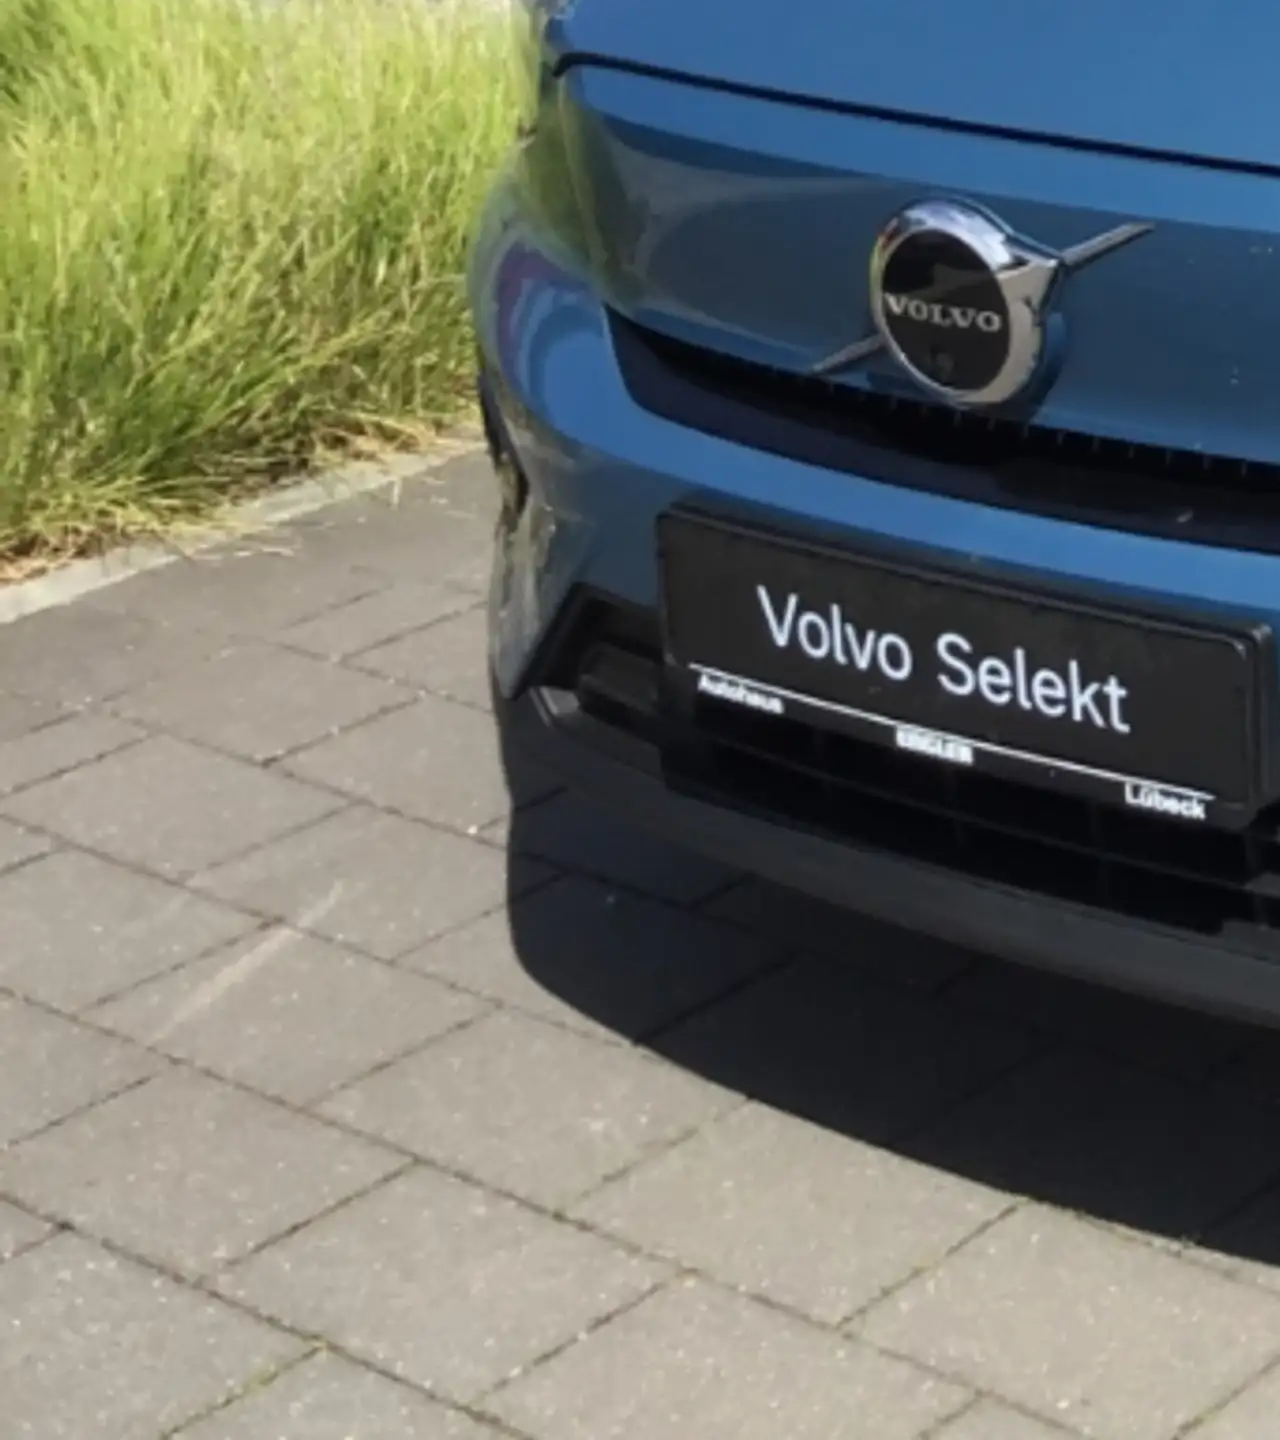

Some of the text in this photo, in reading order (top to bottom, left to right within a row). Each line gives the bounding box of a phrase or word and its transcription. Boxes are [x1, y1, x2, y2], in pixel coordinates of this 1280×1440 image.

[884, 291, 1003, 333] VOLVO
[757, 584, 1130, 734] Volvo Selekt
[1125, 780, 1206, 821] Lübeck
